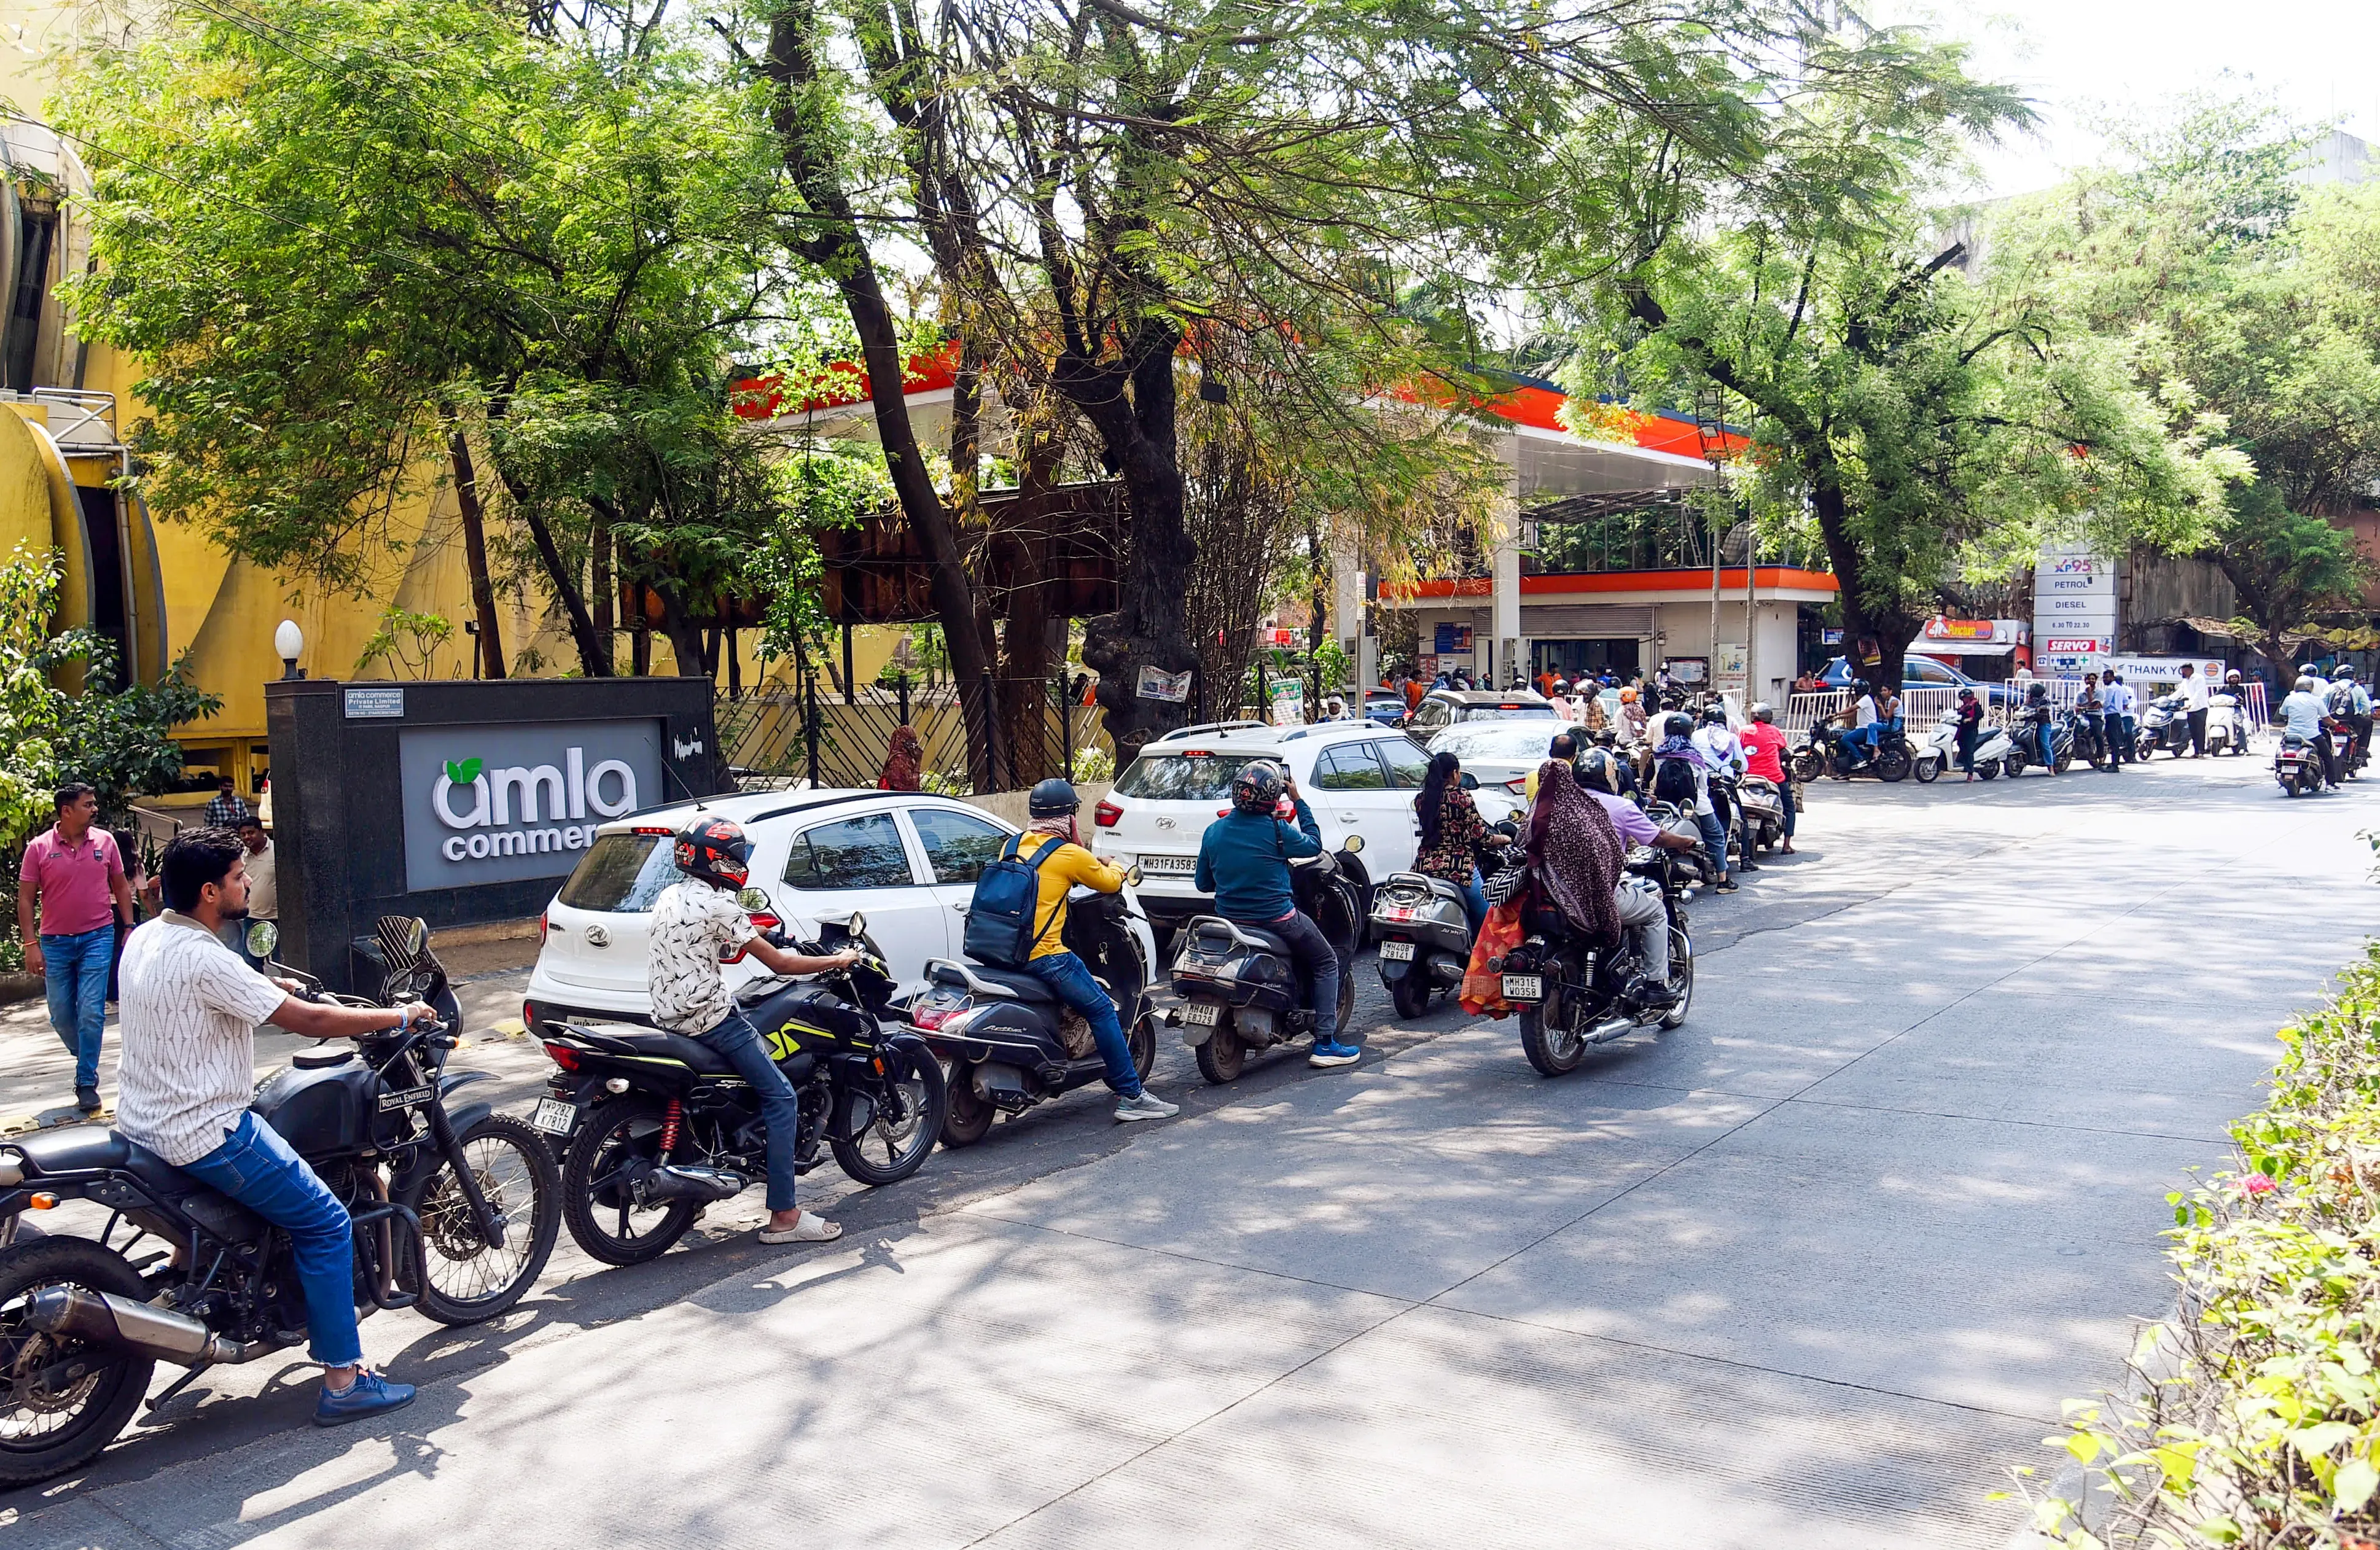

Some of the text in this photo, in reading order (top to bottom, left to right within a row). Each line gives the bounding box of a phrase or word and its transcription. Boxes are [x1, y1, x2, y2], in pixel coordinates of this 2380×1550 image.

[1948, 623, 1976, 636] Puncture
[2050, 641, 2090, 651] SERVO
[2128, 665, 2167, 674] THANK
[432, 747, 637, 829] amla
[442, 824, 597, 861] commer
[1144, 858, 1196, 871] MH31FA3583
[1386, 943, 1410, 952] MH40B
[1386, 951, 1408, 959] Z8141
[1509, 978, 1536, 987] MH31E
[1510, 987, 1536, 996] W0358
[1189, 1004, 1213, 1016] MH40A
[1187, 1013, 1212, 1024] E8329
[382, 1096, 404, 1107] ROYAL
[545, 1100, 572, 1118] MP28Z
[541, 1113, 567, 1130] K7812
